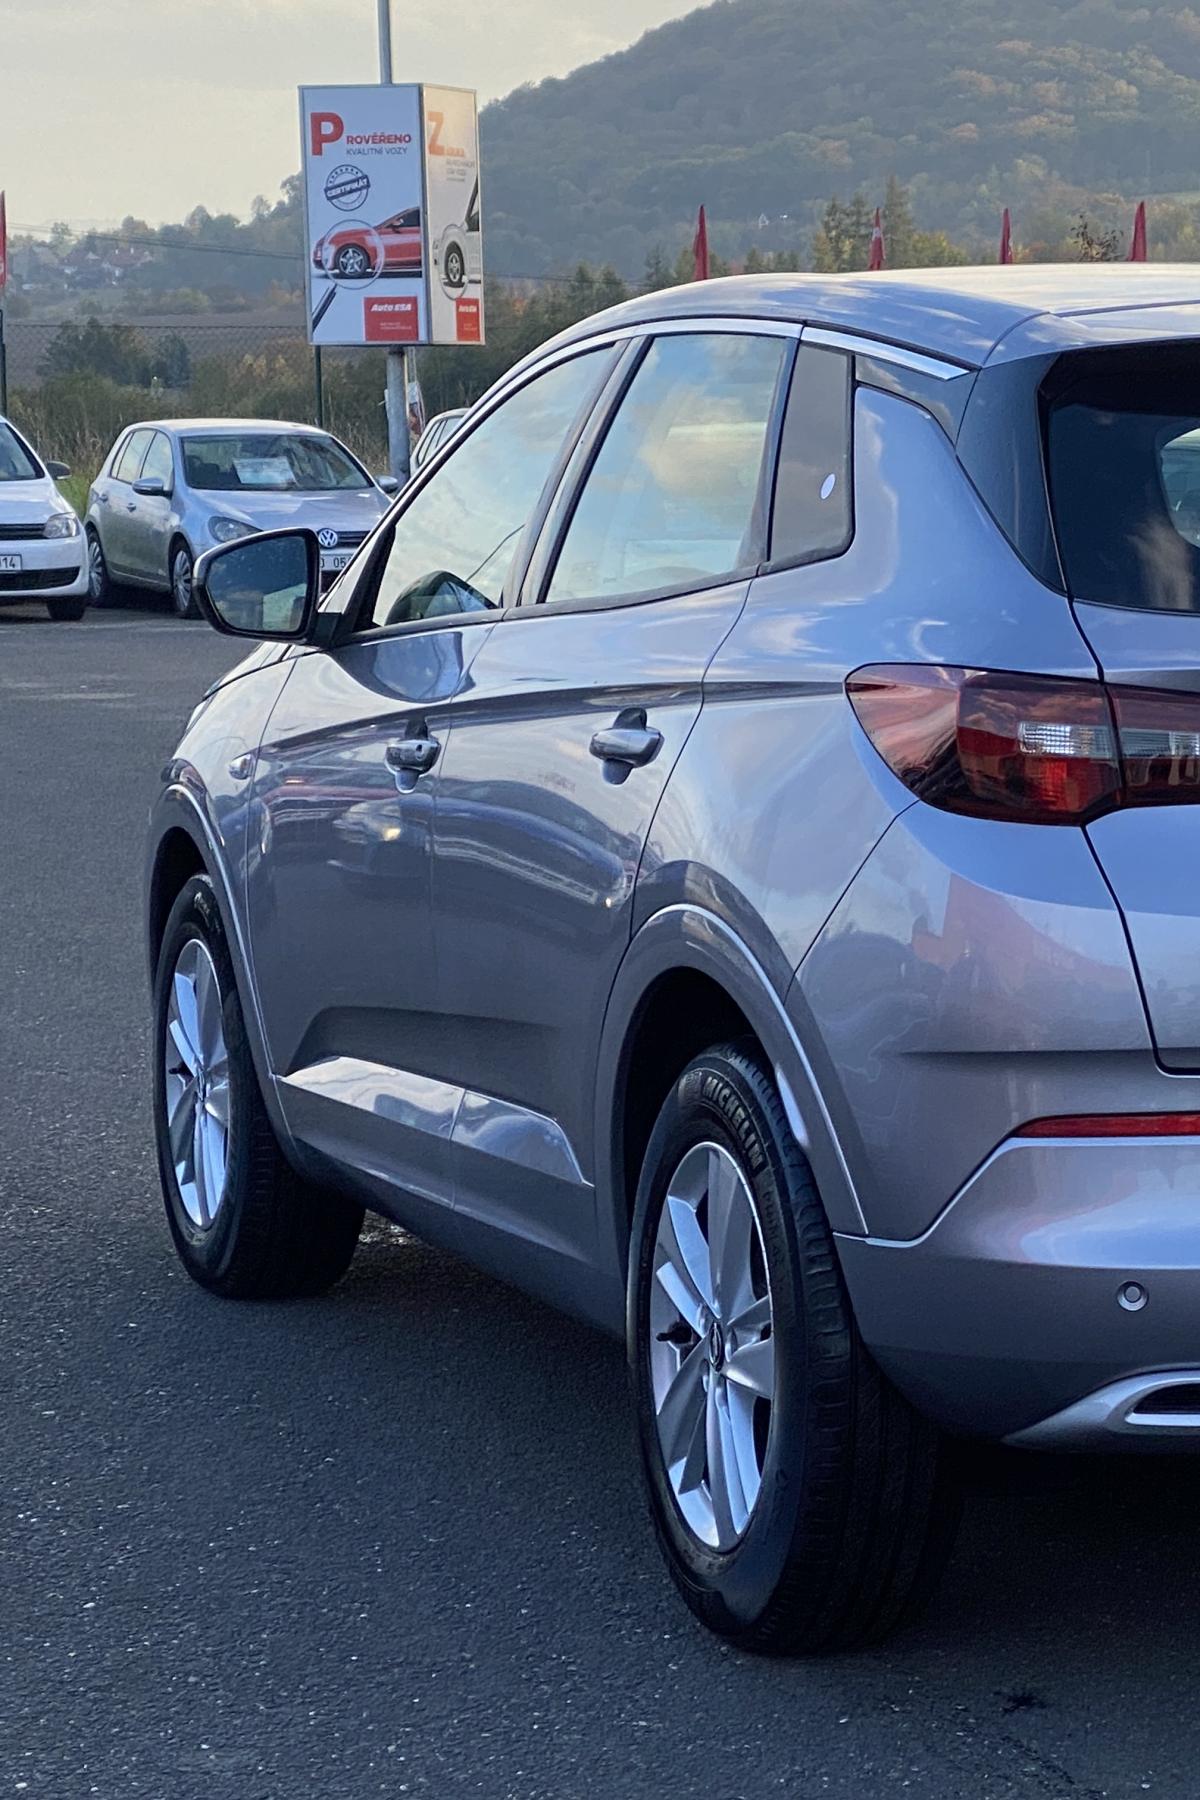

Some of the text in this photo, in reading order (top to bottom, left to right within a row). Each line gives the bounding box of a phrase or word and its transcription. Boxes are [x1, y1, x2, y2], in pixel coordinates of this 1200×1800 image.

[346, 146, 408, 156] KVALITNÍ VOZY
[371, 303, 412, 312] Auto ESA
[0, 556, 16, 569] 14
[702, 1076, 765, 1174] MICHELIN
